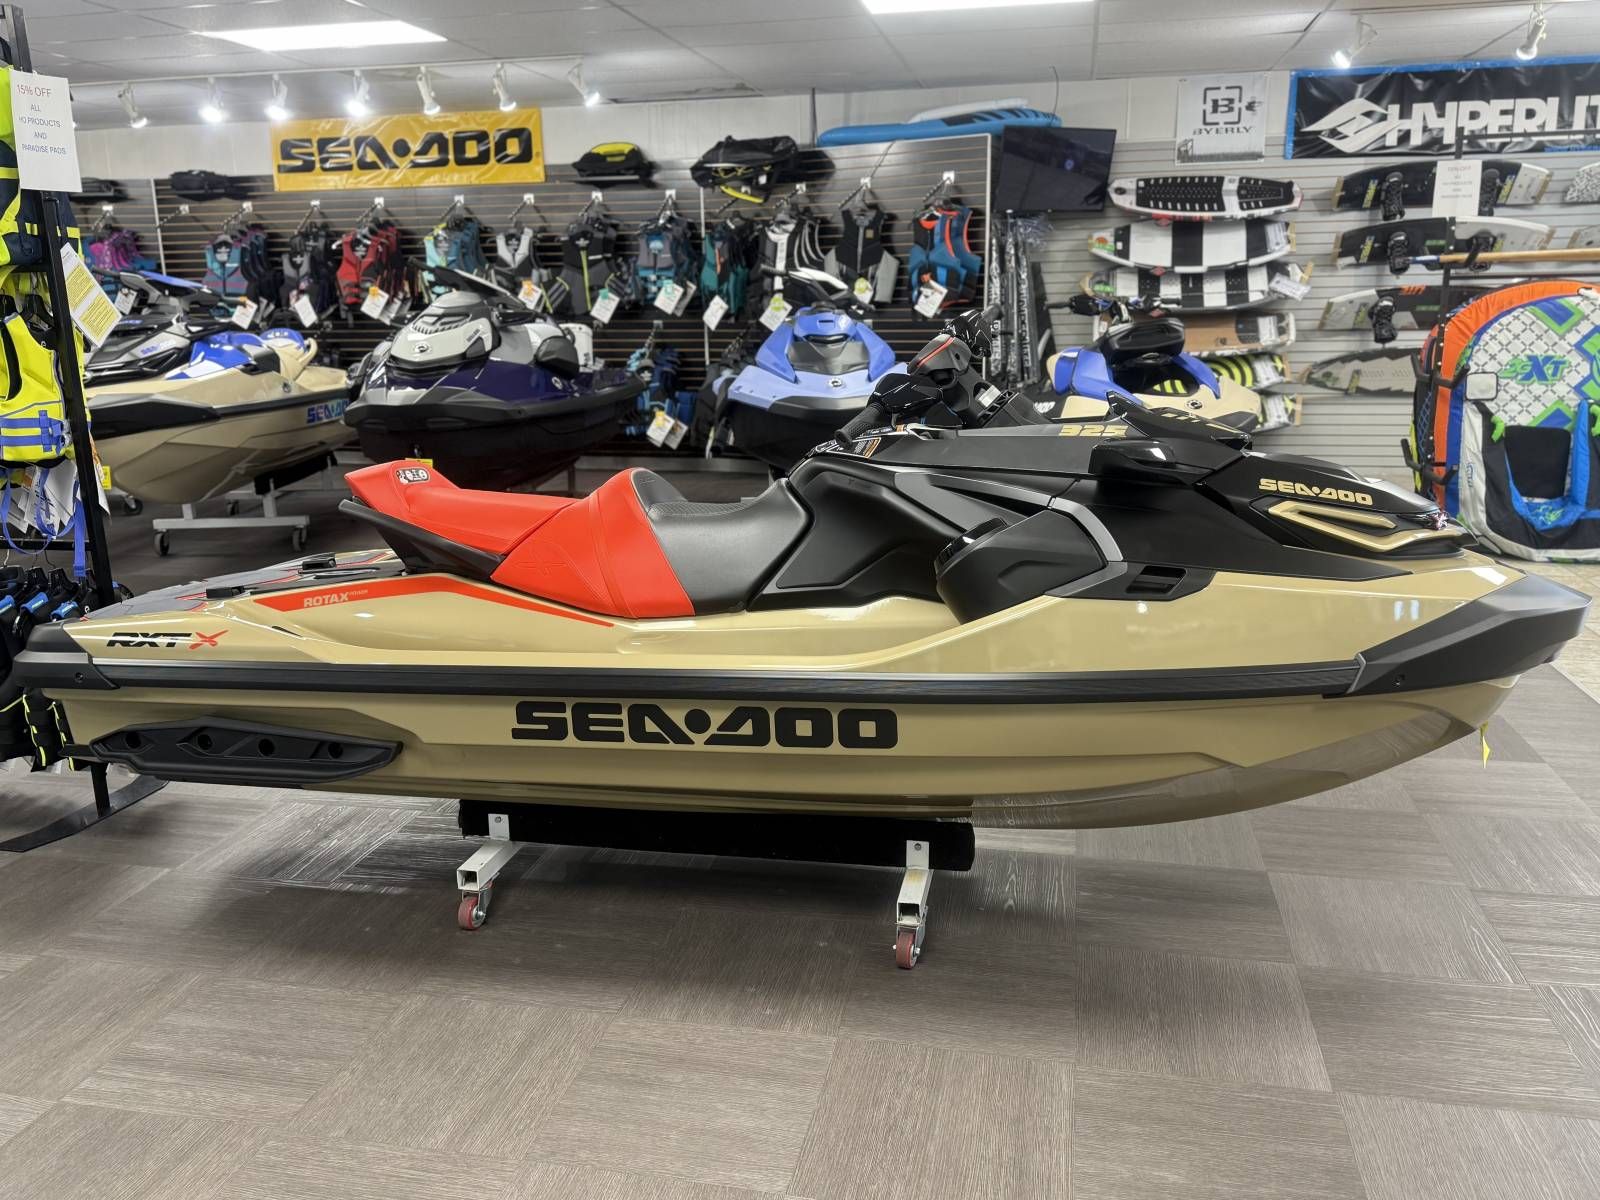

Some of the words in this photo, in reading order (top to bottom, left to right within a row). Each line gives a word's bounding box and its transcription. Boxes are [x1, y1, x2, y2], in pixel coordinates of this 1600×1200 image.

[17, 84, 33, 96] 15%
[35, 87, 51, 97] OFF
[31, 103, 42, 112] ALL
[28, 117, 62, 128] PRODUCTS
[34, 131, 47, 140] AND
[1193, 125, 1253, 136] BYERLY
[22, 143, 49, 154] PARADISE
[50, 146, 66, 155] PADS
[1058, 424, 1129, 438] 325
[304, 592, 349, 608] ROTAX
[106, 632, 192, 648] RXT
